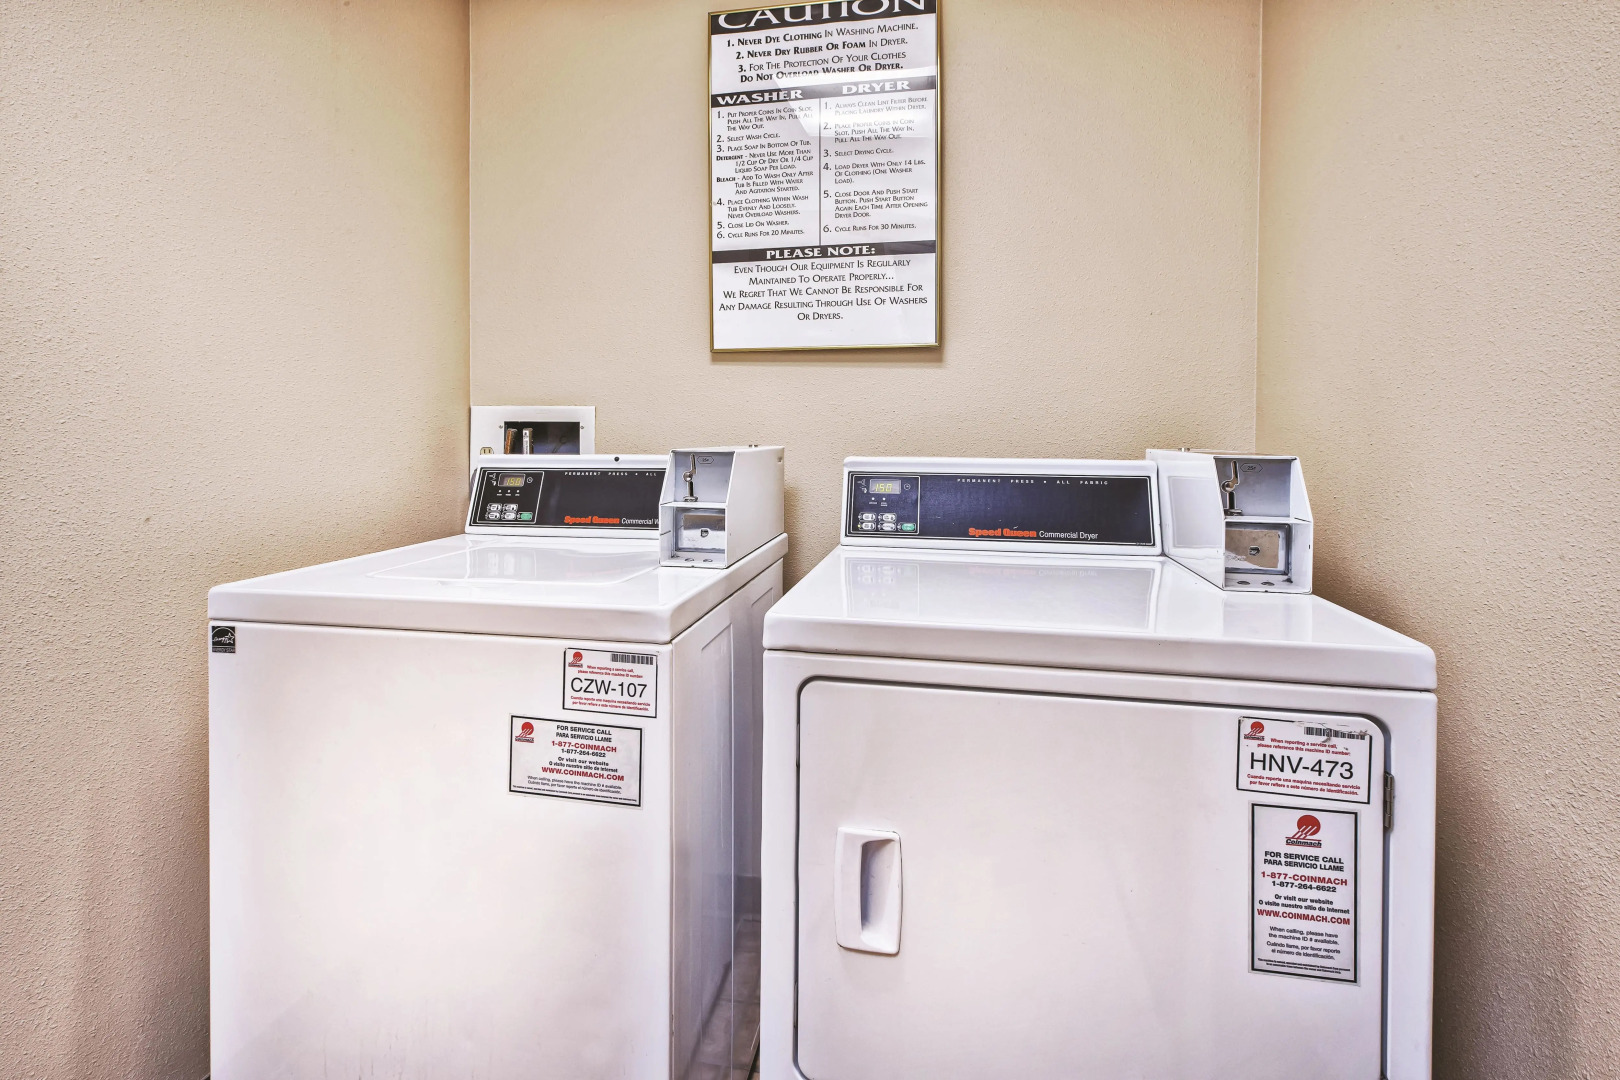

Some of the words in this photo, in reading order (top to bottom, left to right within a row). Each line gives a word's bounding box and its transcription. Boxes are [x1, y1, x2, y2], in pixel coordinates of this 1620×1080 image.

[738, 37, 762, 46] NEVER
[765, 36, 780, 44] DYE
[784, 32, 822, 42] CLOTHING
[825, 30, 832, 38] IN
[836, 27, 874, 37] WASHING
[877, 23, 918, 33] MACHINE.
[747, 50, 771, 58] NEVER
[775, 48, 790, 56] DRY
[794, 46, 823, 54] RUBBER
[842, 41, 866, 49] FOAM
[880, 37, 908, 46] DRYER.
[784, 59, 828, 68] PROTECTION
[846, 54, 868, 62] YOUR
[871, 52, 906, 60] CLOTHES
[741, 75, 753, 83] DO
[822, 66, 855, 74] WASHER
[875, 62, 903, 70] DRYER.
[843, 81, 910, 94] DRYER
[717, 90, 803, 104] WASHER
[766, 248, 821, 259] PLEASE
[827, 246, 875, 255] NOTE:
[734, 265, 753, 274] EVEN
[756, 264, 787, 272] THOUGH
[790, 263, 808, 271] OUR
[811, 261, 854, 271] EQUIPMENT
[867, 259, 911, 267] REGULARLY
[749, 276, 796, 285] MAINTAINED
[798, 275, 809, 283] TO
[813, 274, 846, 282] OPERATE
[849, 272, 893, 281] PROPERLY...
[739, 290, 765, 298] REGRET
[790, 288, 803, 296] WE
[806, 287, 838, 295] CANNOT
[841, 286, 851, 294] BE
[855, 285, 904, 293] RESPONSIBLE
[719, 303, 735, 311] ANY
[738, 302, 771, 310] DAMAGE
[775, 301, 813, 309] RESULTING
[816, 299, 853, 307] THROUGH
[856, 298, 871, 306] USE
[874, 297, 887, 305] OF
[889, 297, 927, 305] WASHERS
[813, 312, 843, 320] DRYERS.
[564, 516, 591, 524] Speed
[969, 528, 1001, 537] Speed
[1003, 528, 1036, 537] Queen
[1080, 532, 1098, 540] Dryer
[571, 677, 647, 698] CZW-107
[552, 741, 616, 752] 1-877-COINMACH
[1251, 752, 1353, 779] HNV-473
[542, 767, 624, 781] WWW.COINMACH.COM
[1284, 853, 1319, 861] SERVICE
[1284, 861, 1317, 869] SERVICIO
[1320, 864, 1344, 872] LLAME
[1261, 871, 1347, 886] 1-877-COINMACH
[1272, 881, 1336, 892] 1-877-264-6622
[1257, 909, 1350, 924] WWW.COINMACH.COM
